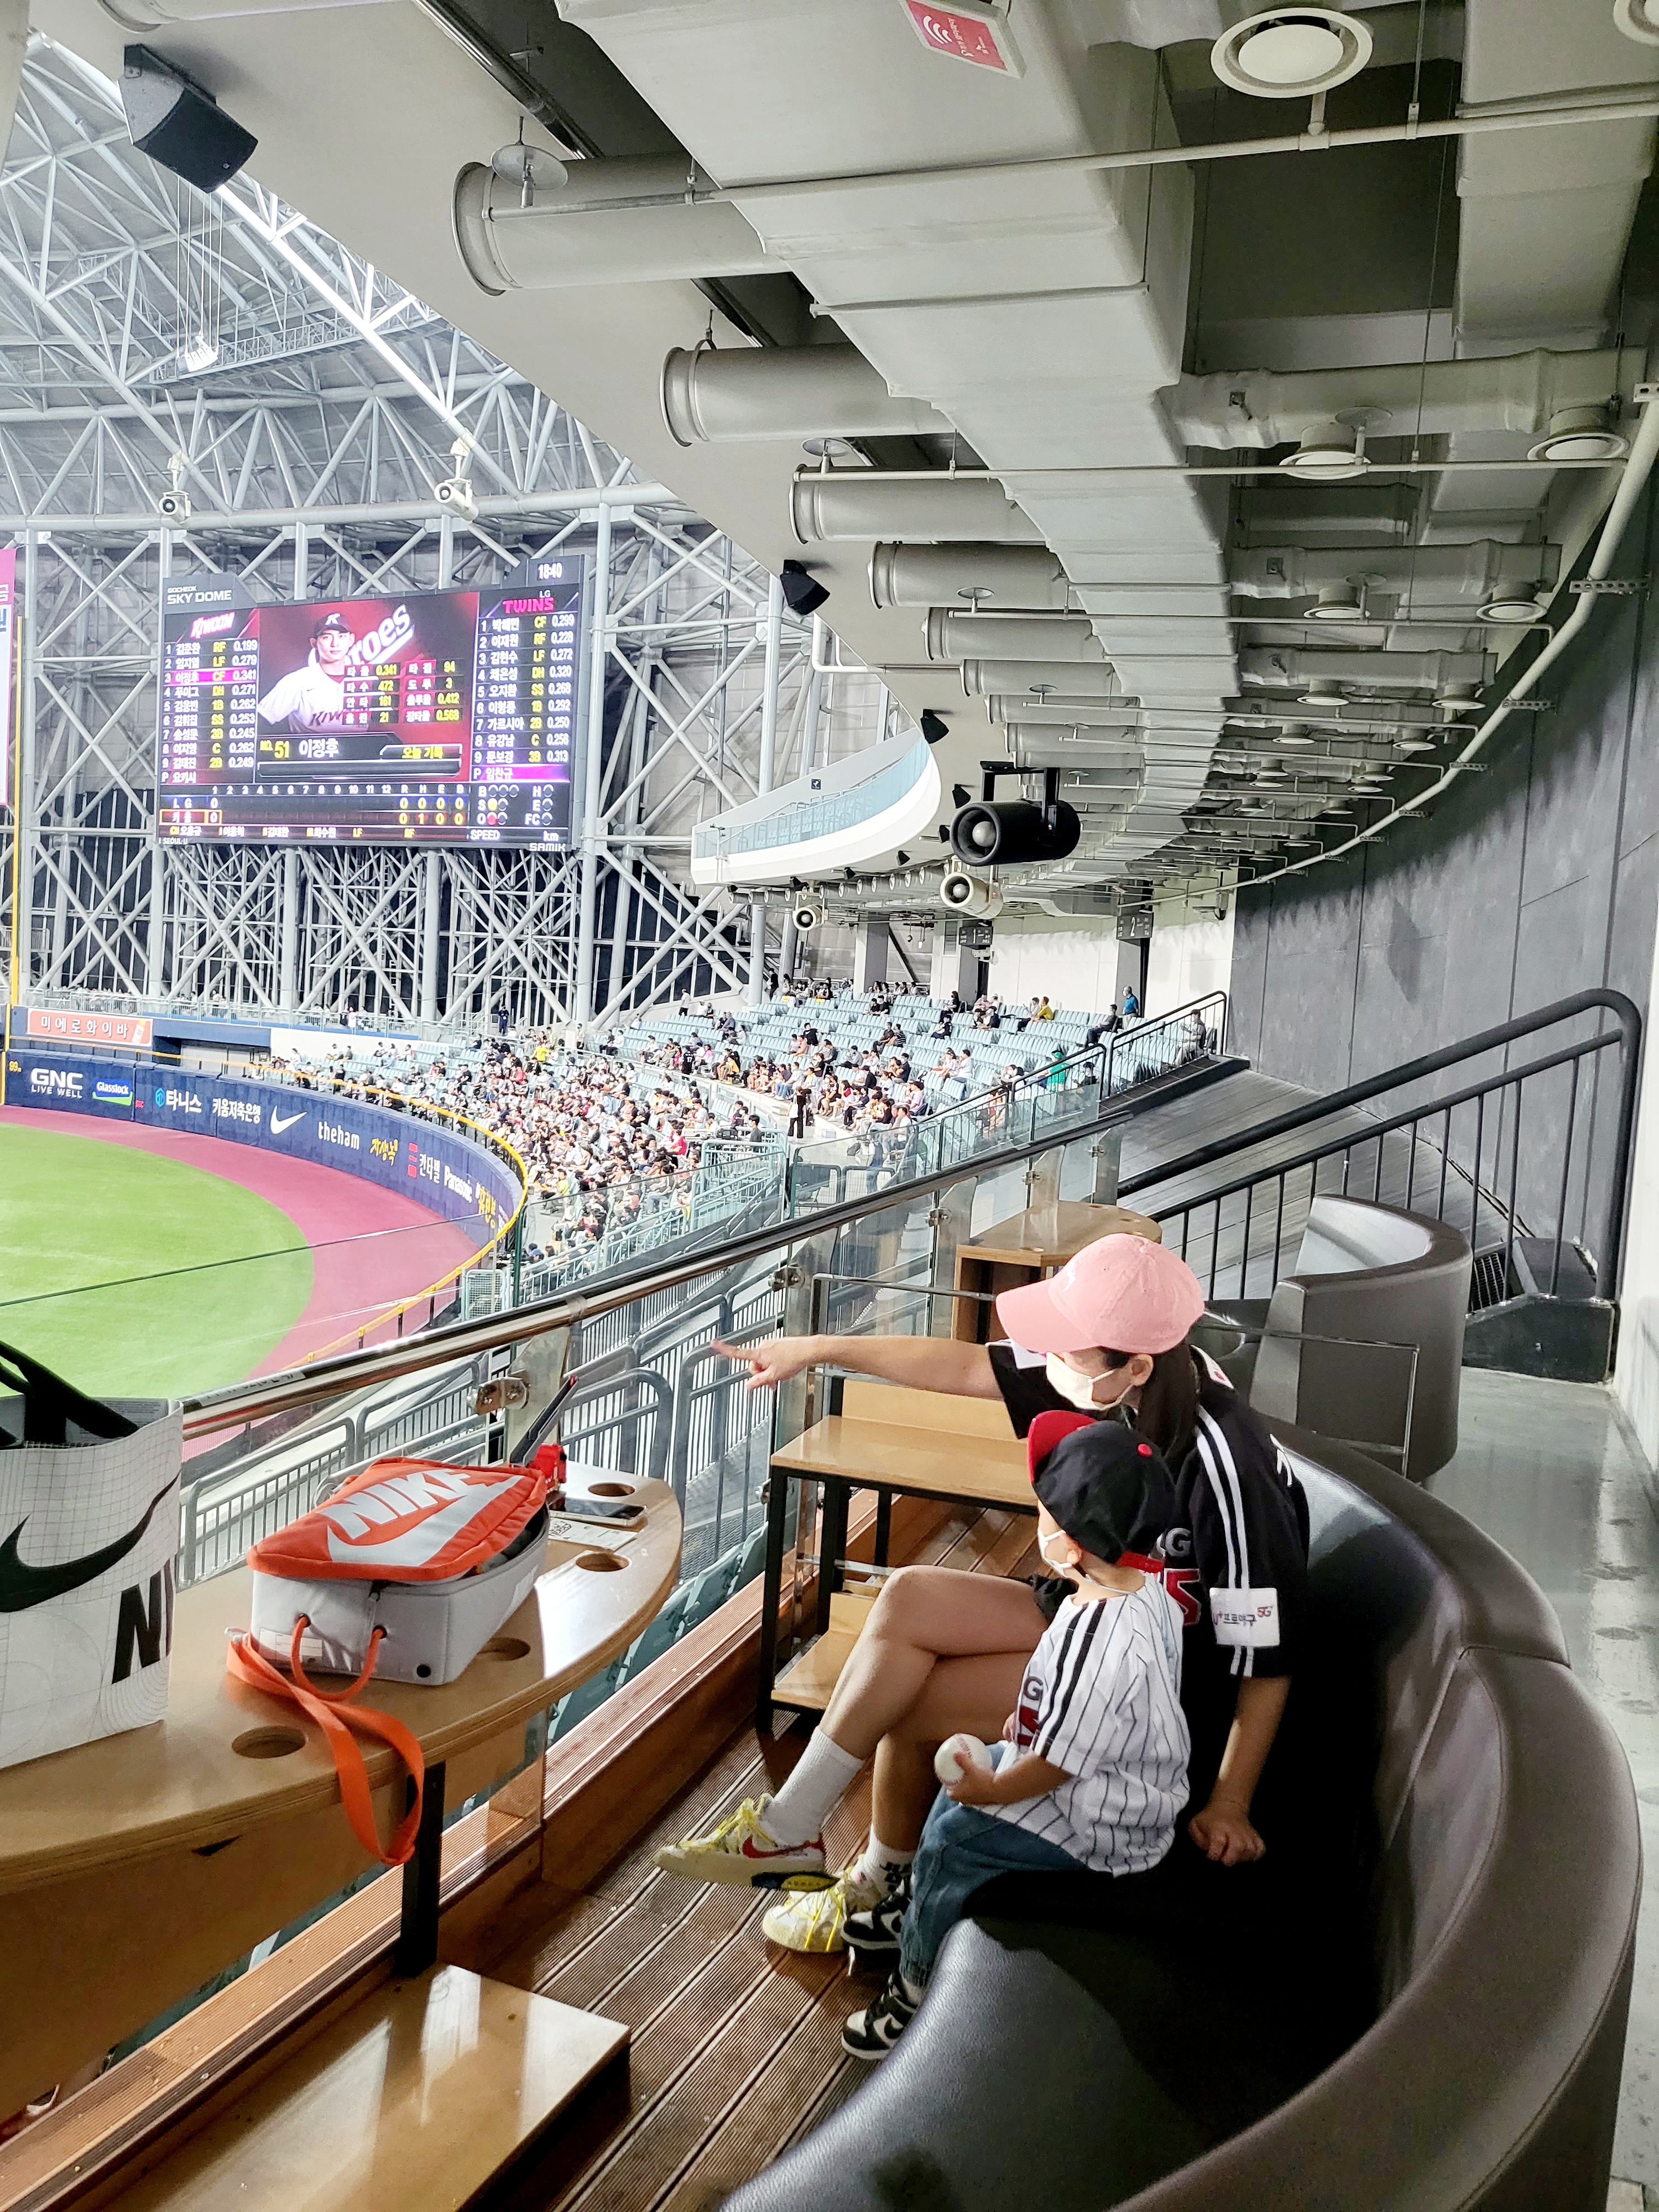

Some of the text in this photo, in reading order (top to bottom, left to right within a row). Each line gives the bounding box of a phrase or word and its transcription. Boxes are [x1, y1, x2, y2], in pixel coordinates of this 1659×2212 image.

[538, 562, 562, 580] 18:40
[167, 589, 232, 604] SKY DOME
[539, 589, 551, 598] LG
[502, 597, 554, 614] TWINS
[325, 613, 341, 625] K
[481, 620, 487, 632] 1
[534, 616, 546, 628] CF
[552, 614, 575, 627] 0.299
[479, 631, 573, 648] 2 이재원 RF 0.228
[165, 644, 171, 654] 1
[213, 641, 226, 653] RF
[233, 640, 258, 651] 0.199
[165, 659, 171, 669] 2
[213, 656, 226, 667] LF
[232, 655, 257, 666] 0.279
[479, 648, 573, 665] 3 김현수 LF 0.272
[376, 664, 397, 676] 0.341
[444, 660, 456, 672] 94
[165, 669, 257, 684] 3 이정후 CF 0.341
[478, 665, 572, 681] 4 채은성 DH 0.320
[378, 680, 394, 691] 472
[445, 677, 452, 689] 3
[477, 682, 571, 697] 5 오지환 SS 0.268
[164, 684, 256, 698] 4 푸이그 DH 0.271
[164, 701, 170, 711] 5
[212, 700, 224, 710] 1B
[231, 698, 255, 709] 0.262
[379, 695, 392, 707] 161
[437, 692, 460, 705] 0.412
[477, 702, 484, 714] 6
[531, 700, 542, 712] 1B
[548, 699, 571, 711] 0.292
[163, 715, 170, 726] 6
[211, 713, 224, 725] SS
[230, 713, 255, 724] 0.253
[379, 712, 389, 723] 21
[436, 709, 459, 721] 0.568
[476, 716, 570, 731] 7 가르시아 2B 0.250
[163, 729, 170, 740] 7
[210, 728, 224, 739] 3B
[229, 727, 255, 739] 0.245
[474, 733, 569, 747] 8 유강남 C 0.256
[163, 742, 254, 755] 8 이지영 C 0.262
[274, 740, 290, 758] 51
[299, 738, 339, 758] 이정후
[402, 746, 443, 759] 오늘 기록
[162, 758, 169, 768] 9
[209, 757, 223, 768] 2B
[228, 757, 254, 768] 0.249
[474, 750, 568, 764] 9 문보경 3B 0.313
[161, 771, 196, 784] P 요키시
[473, 767, 513, 780] P 임찬규
[401, 784, 465, 794] R H E B
[478, 785, 487, 797] B
[533, 785, 541, 797] H
[210, 797, 218, 808] 0
[399, 797, 408, 810] 0
[418, 797, 426, 810] 0
[436, 797, 445, 810] 0
[455, 797, 464, 810] 0
[478, 799, 486, 811] S
[533, 800, 541, 811] E
[210, 812, 218, 823] 0
[399, 812, 408, 825] 0
[418, 813, 425, 825] 1
[436, 812, 445, 825] 0
[454, 812, 463, 825] 0
[525, 813, 540, 825] FC
[471, 830, 559, 841] SPEED km
[529, 843, 566, 852] SAMIK
[1130, 916, 1135, 937] 2
[973, 928, 976, 944] 1
[30, 1068, 84, 1090] GNC
[31, 1084, 83, 1099] LIVE WELL
[96, 1081, 129, 1095] Glasslock
[166, 1089, 202, 1114] 타니스
[212, 1098, 261, 1124] 키움저축은행
[318, 1121, 360, 1150] theham
[444, 1165, 472, 1203] Panasonic
[318, 1468, 477, 1540] NIKE
